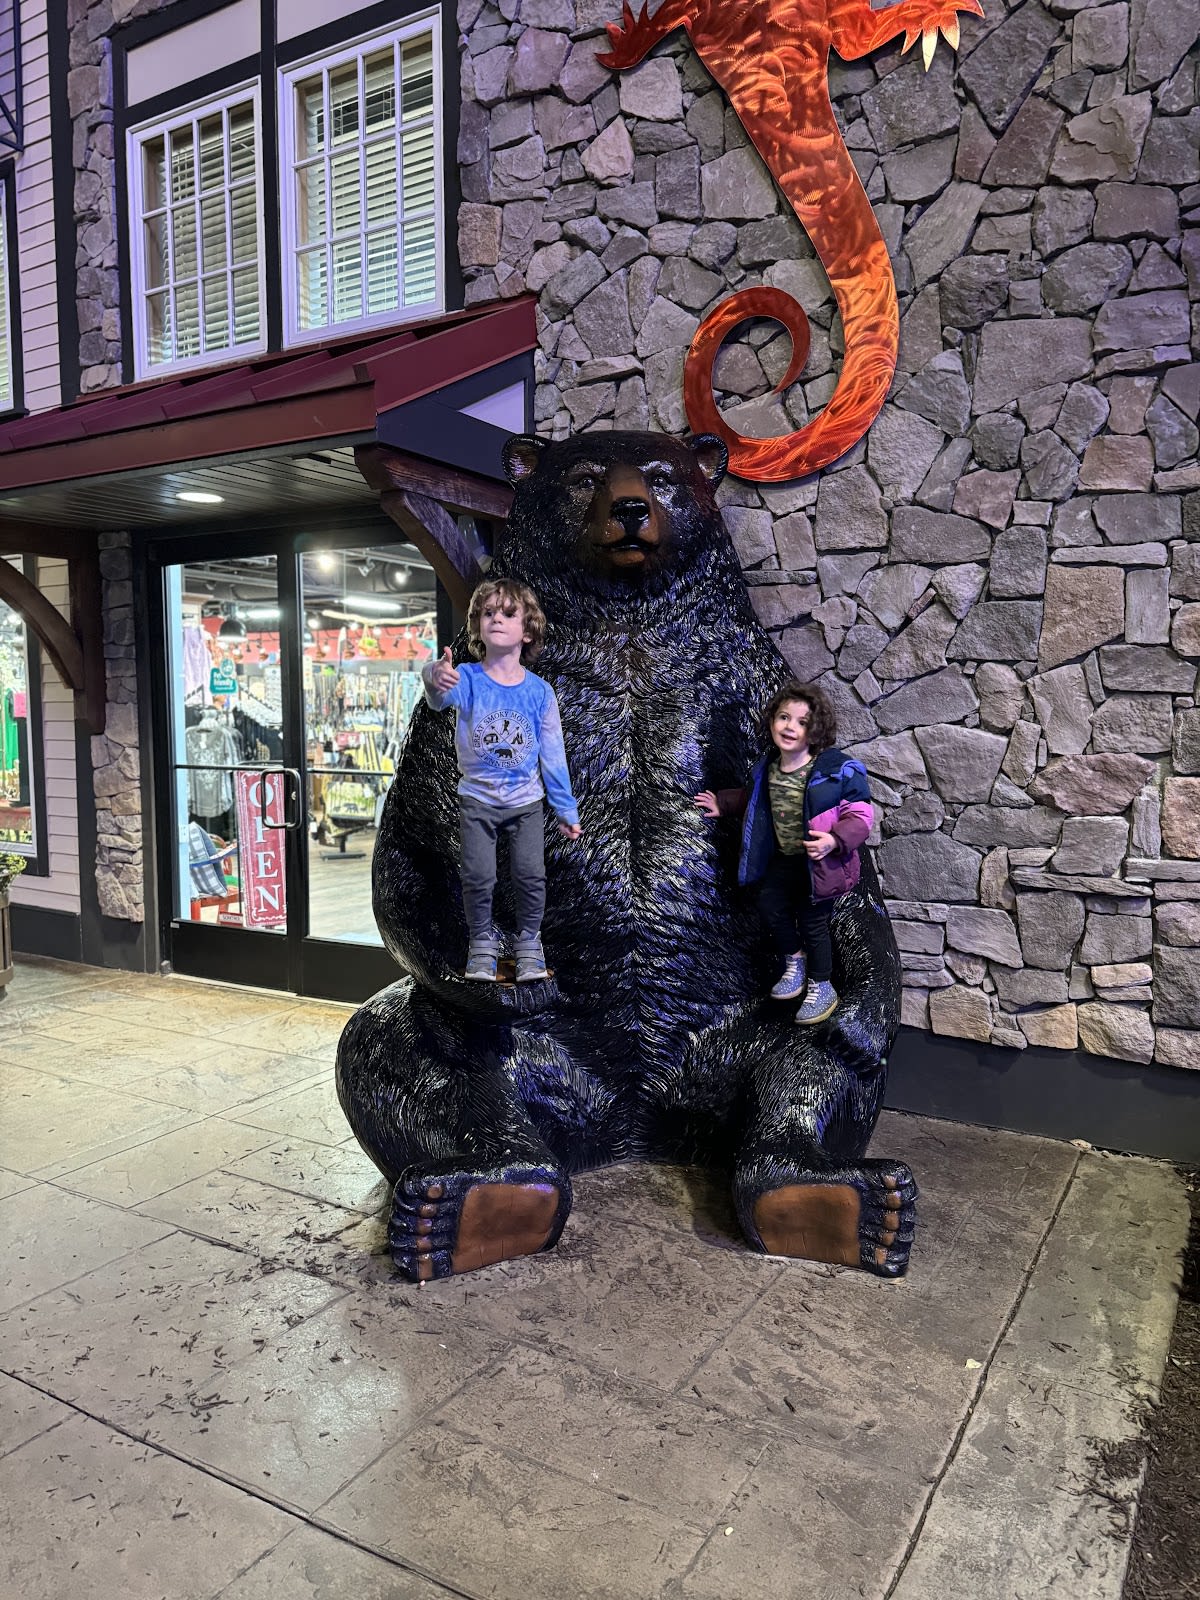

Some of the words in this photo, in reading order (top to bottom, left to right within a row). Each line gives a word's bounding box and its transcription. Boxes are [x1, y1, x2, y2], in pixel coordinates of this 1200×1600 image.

[474, 725, 485, 748] GREAT
[484, 711, 508, 725] SMOKY
[511, 712, 534, 749] MOUNTAINS
[480, 752, 525, 768] TENNESSEE
[249, 780, 281, 913] OPEN
